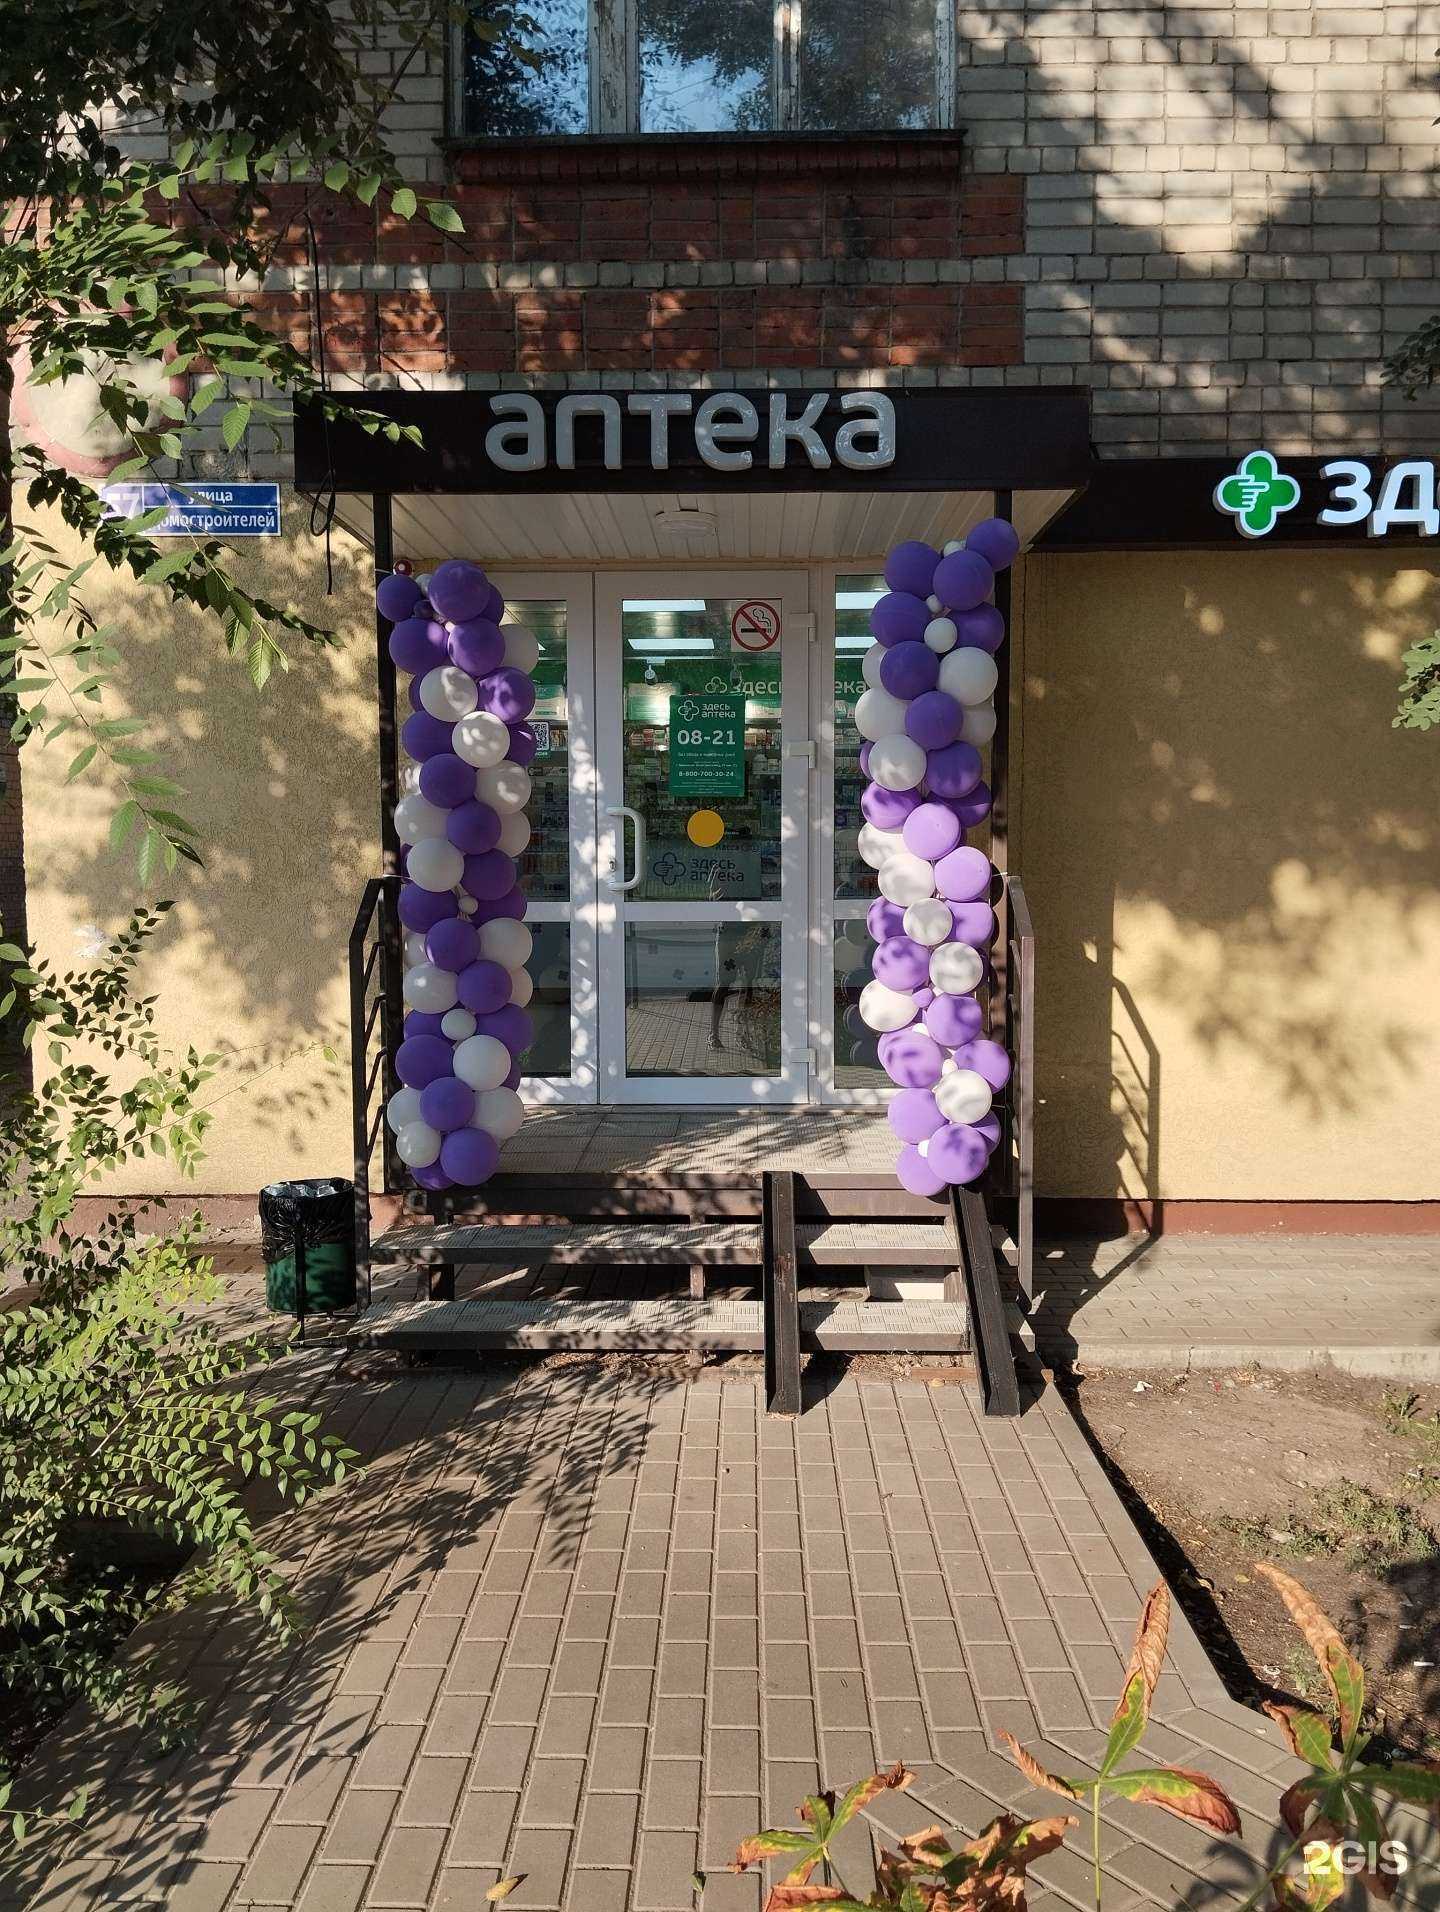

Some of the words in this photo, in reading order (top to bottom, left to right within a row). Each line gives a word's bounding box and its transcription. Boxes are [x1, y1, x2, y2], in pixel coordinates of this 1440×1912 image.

[485, 390, 898, 472] аптека
[1317, 460, 1440, 538] зд
[156, 511, 276, 531] омостроителей
[701, 711, 736, 719] аптека
[702, 703, 730, 711] здесь
[677, 729, 736, 745] 08-21
